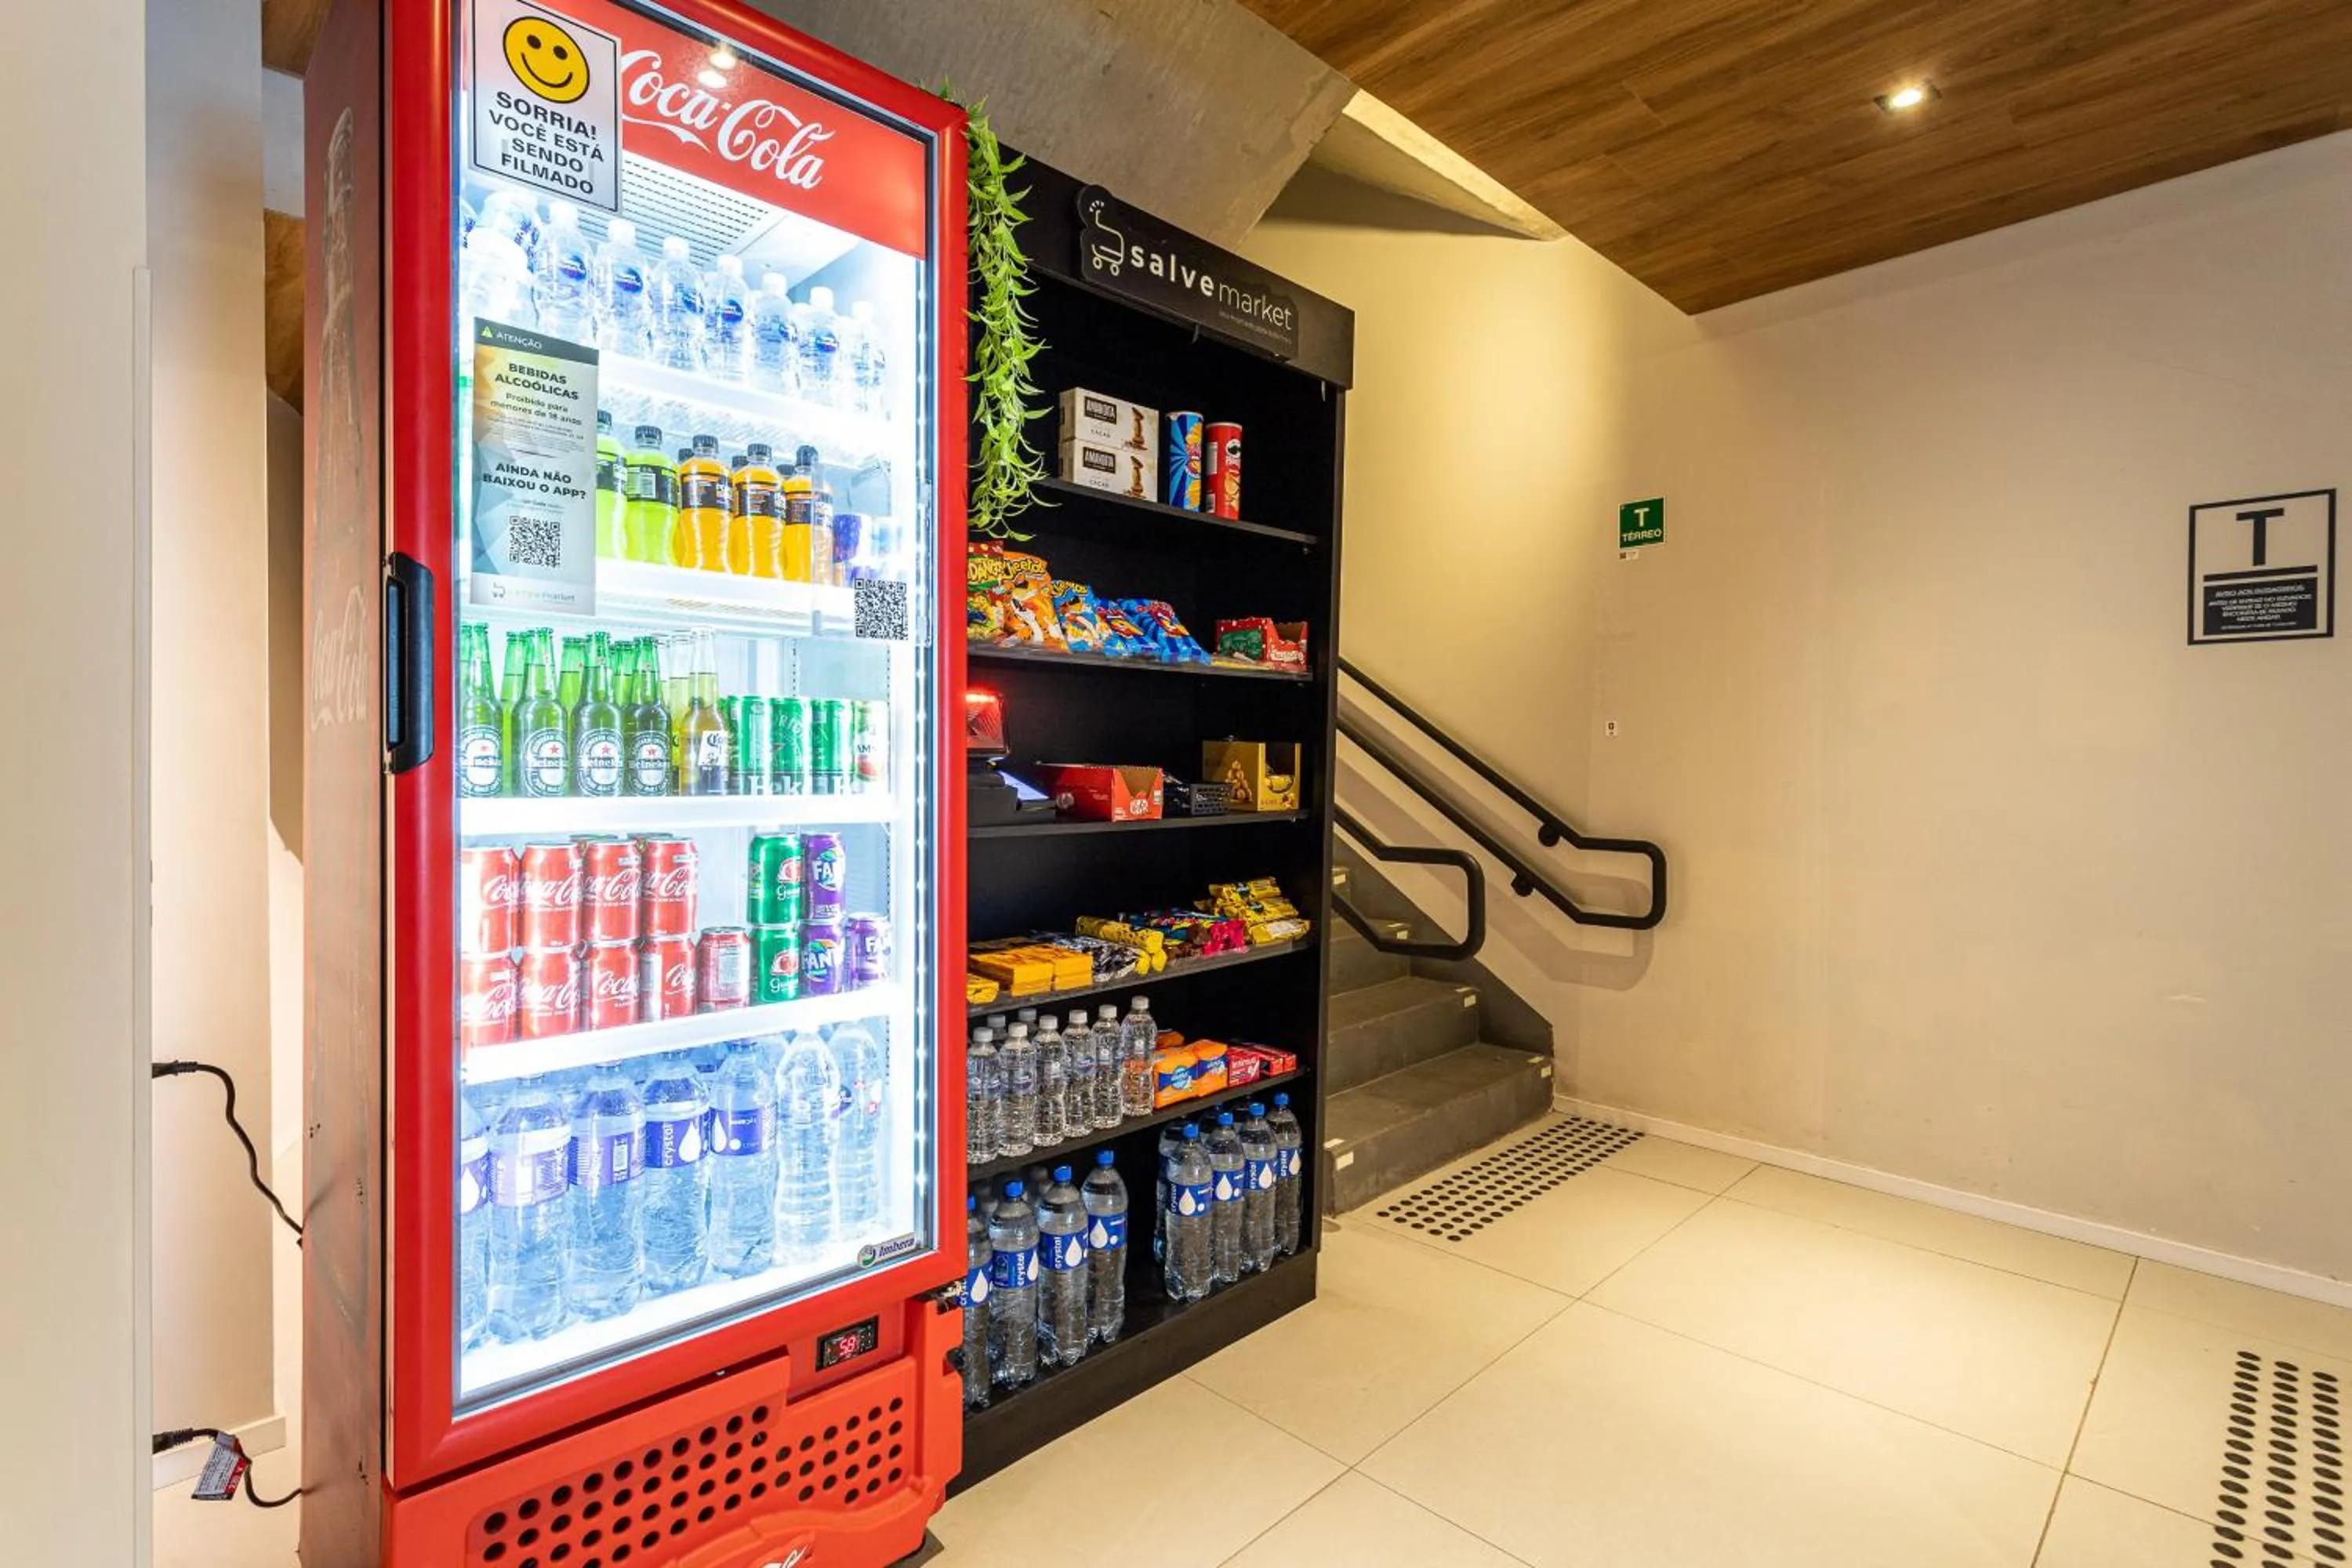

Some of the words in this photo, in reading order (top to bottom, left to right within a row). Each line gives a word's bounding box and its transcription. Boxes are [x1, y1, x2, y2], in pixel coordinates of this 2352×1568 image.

[496, 91, 597, 140] SORRIA!
[488, 109, 546, 142] VOCÊ
[554, 133, 604, 162] ESTÁ
[512, 138, 584, 173] SENDO
[501, 152, 593, 194] FILMADO
[1130, 245, 1214, 296] salve
[1218, 282, 1292, 331] market
[496, 331, 543, 350] ATENÇÃO
[495, 373, 579, 401] ALCOÓLICAS
[509, 363, 568, 385] BEBIDAS
[482, 473, 535, 491] BAIXOU
[539, 483, 550, 493] O
[553, 485, 587, 499] APP?
[495, 462, 539, 479] AINDA
[543, 470, 572, 484] NÃO
[1633, 507, 1650, 528] T
[2236, 507, 2285, 567] T
[663, 1122, 675, 1166] crystal
[1016, 1252, 1025, 1286] crystal
[1053, 1236, 1062, 1269] crystal
